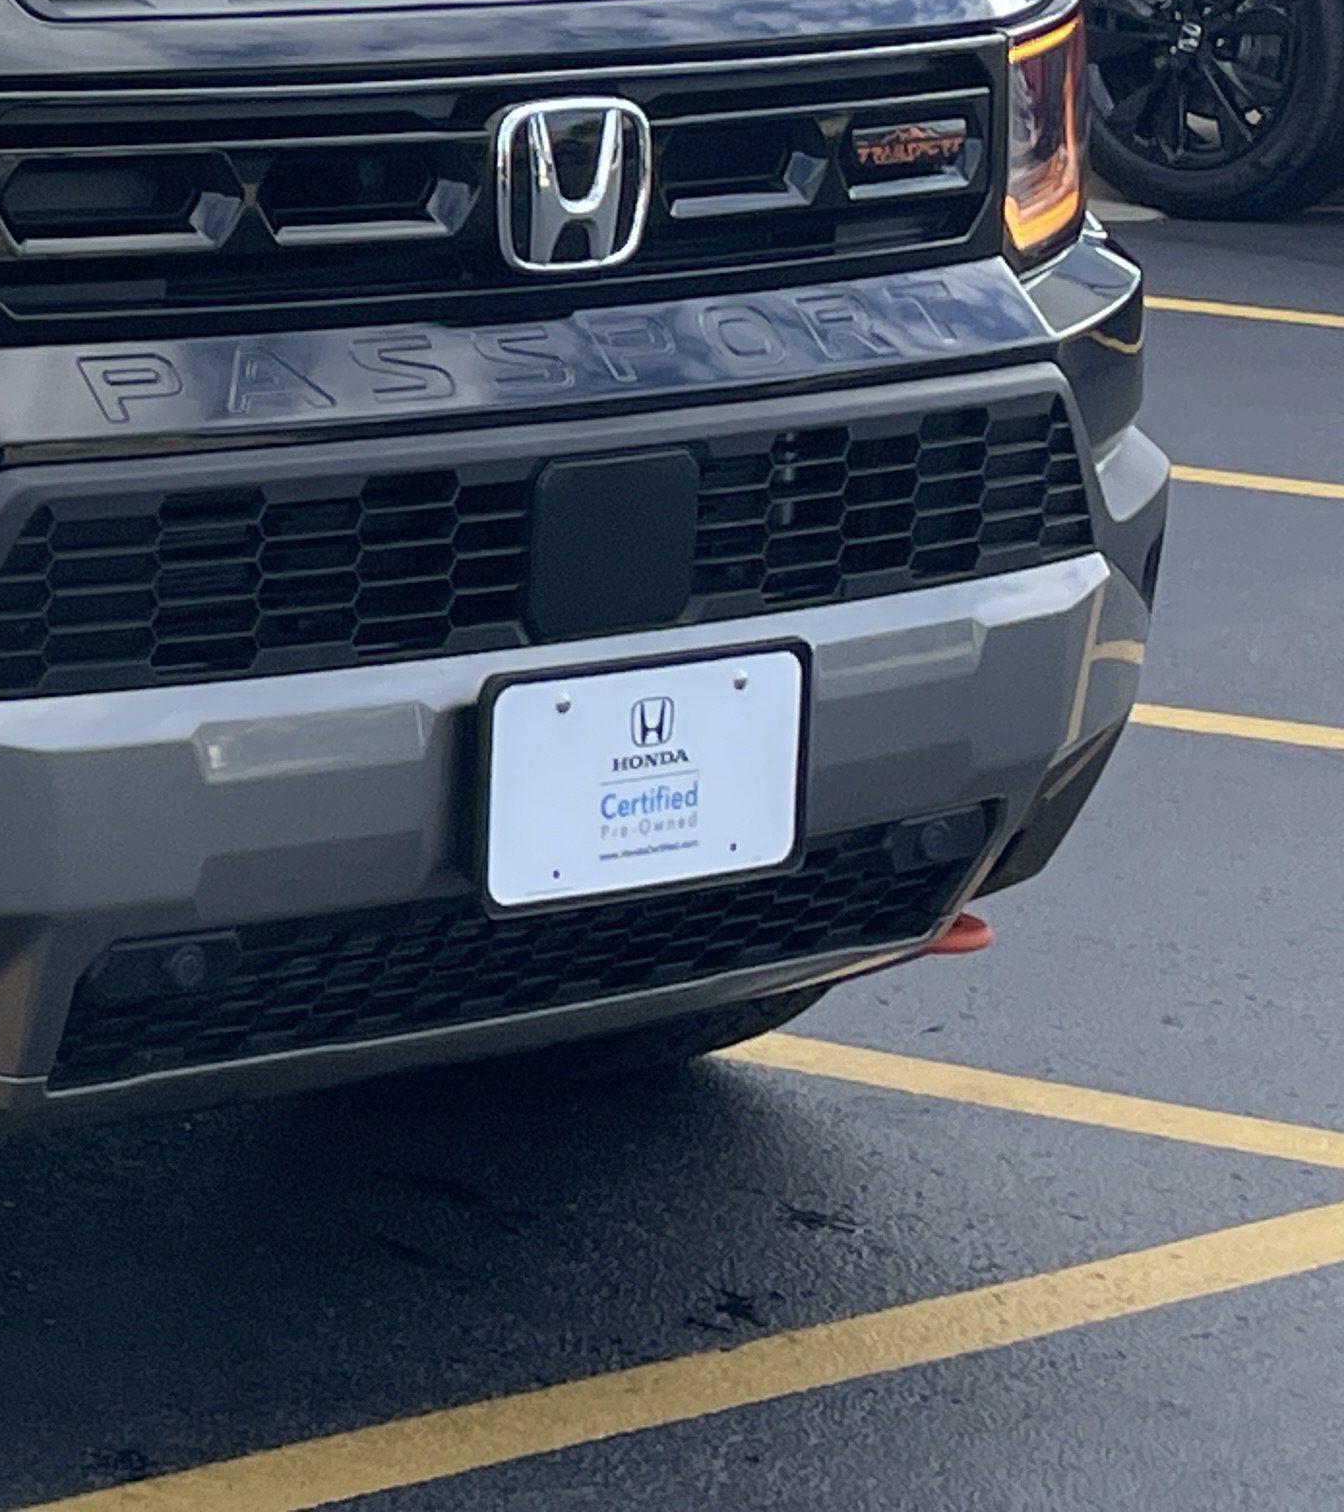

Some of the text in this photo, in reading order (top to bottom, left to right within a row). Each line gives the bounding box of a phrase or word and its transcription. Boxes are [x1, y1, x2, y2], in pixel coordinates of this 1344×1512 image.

[76, 280, 957, 425] PASSPORT
[612, 748, 690, 772] HONDA
[600, 780, 699, 820] Certified
[600, 811, 699, 839] Pre-Owned
